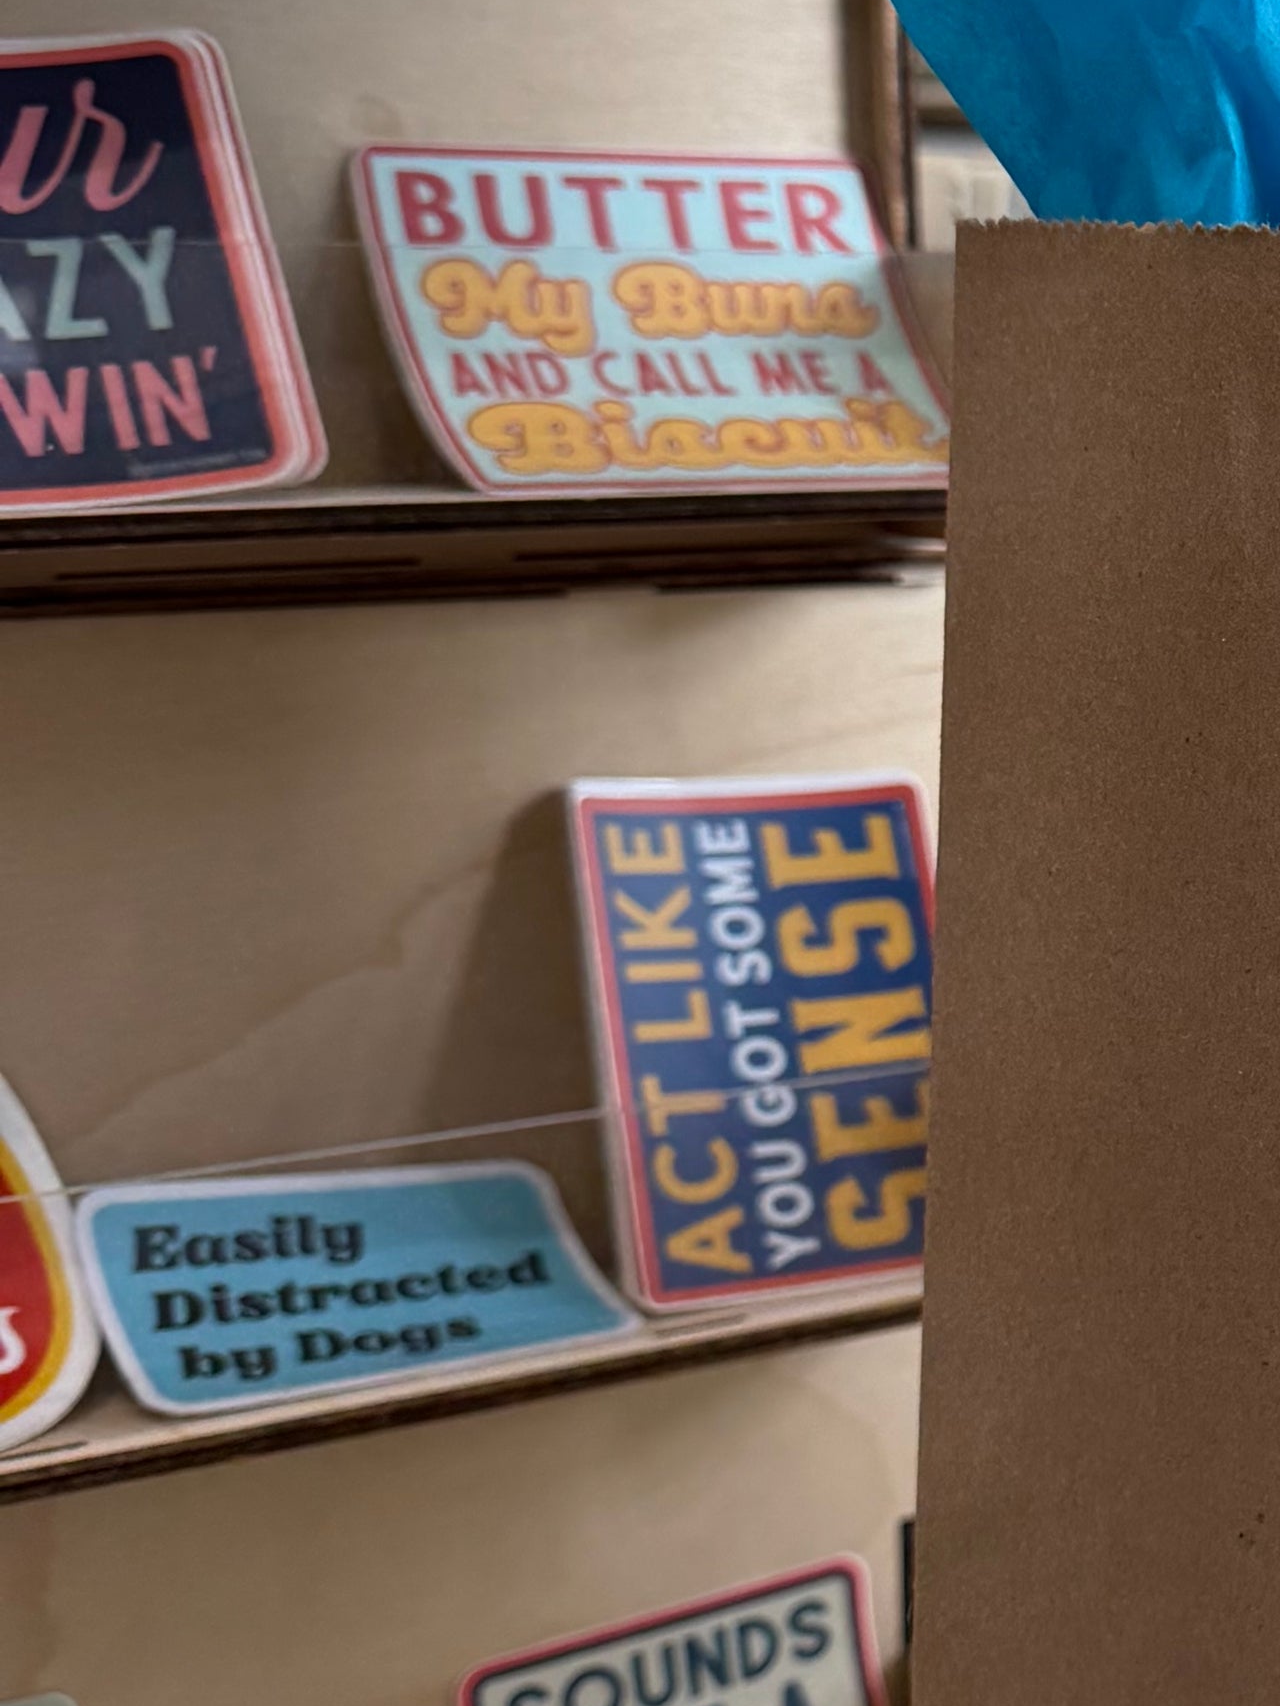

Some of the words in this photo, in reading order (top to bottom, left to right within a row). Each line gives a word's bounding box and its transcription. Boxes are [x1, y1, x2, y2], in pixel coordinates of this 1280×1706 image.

[394, 171, 852, 255] BUTTER
[420, 257, 598, 358] My
[610, 260, 880, 340] Buns
[448, 349, 570, 397] AND
[590, 349, 737, 397] CALL
[748, 351, 840, 397] ME
[852, 351, 893, 395] A
[464, 397, 949, 475] Biscuit
[605, 819, 713, 1045] LIKE
[696, 815, 775, 989] SOME
[722, 1001, 800, 1129] GOT
[758, 813, 930, 1253] SENSE
[640, 1073, 754, 1277] ACT
[750, 1141, 822, 1273] YOU
[130, 1215, 366, 1273] Easily
[152, 1248, 553, 1334] Distracted
[177, 1341, 276, 1383] by
[293, 1313, 484, 1363] Dogs
